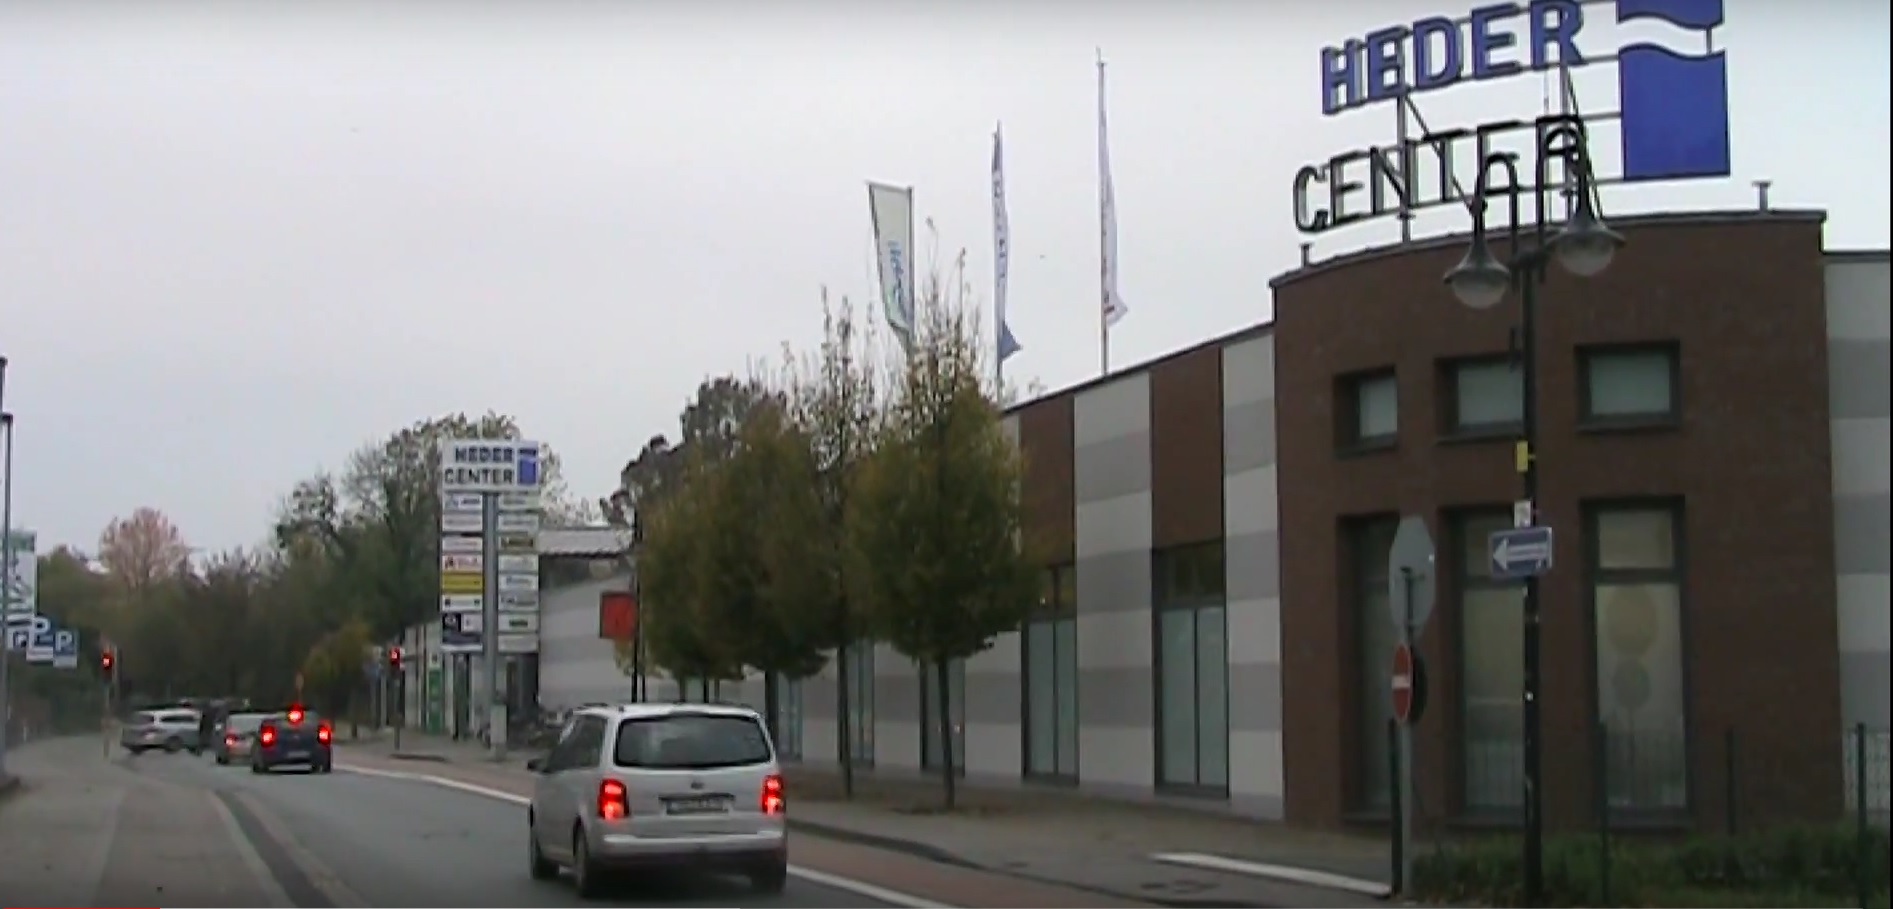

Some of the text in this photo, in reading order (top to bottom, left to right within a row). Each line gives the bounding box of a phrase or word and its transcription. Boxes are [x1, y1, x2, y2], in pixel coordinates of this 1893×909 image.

[1320, 0, 1584, 115] HEDER
[1293, 114, 1588, 233] CENTER
[455, 446, 514, 463] HEDER
[444, 467, 513, 485] CENTER
[55, 631, 73, 652] P
